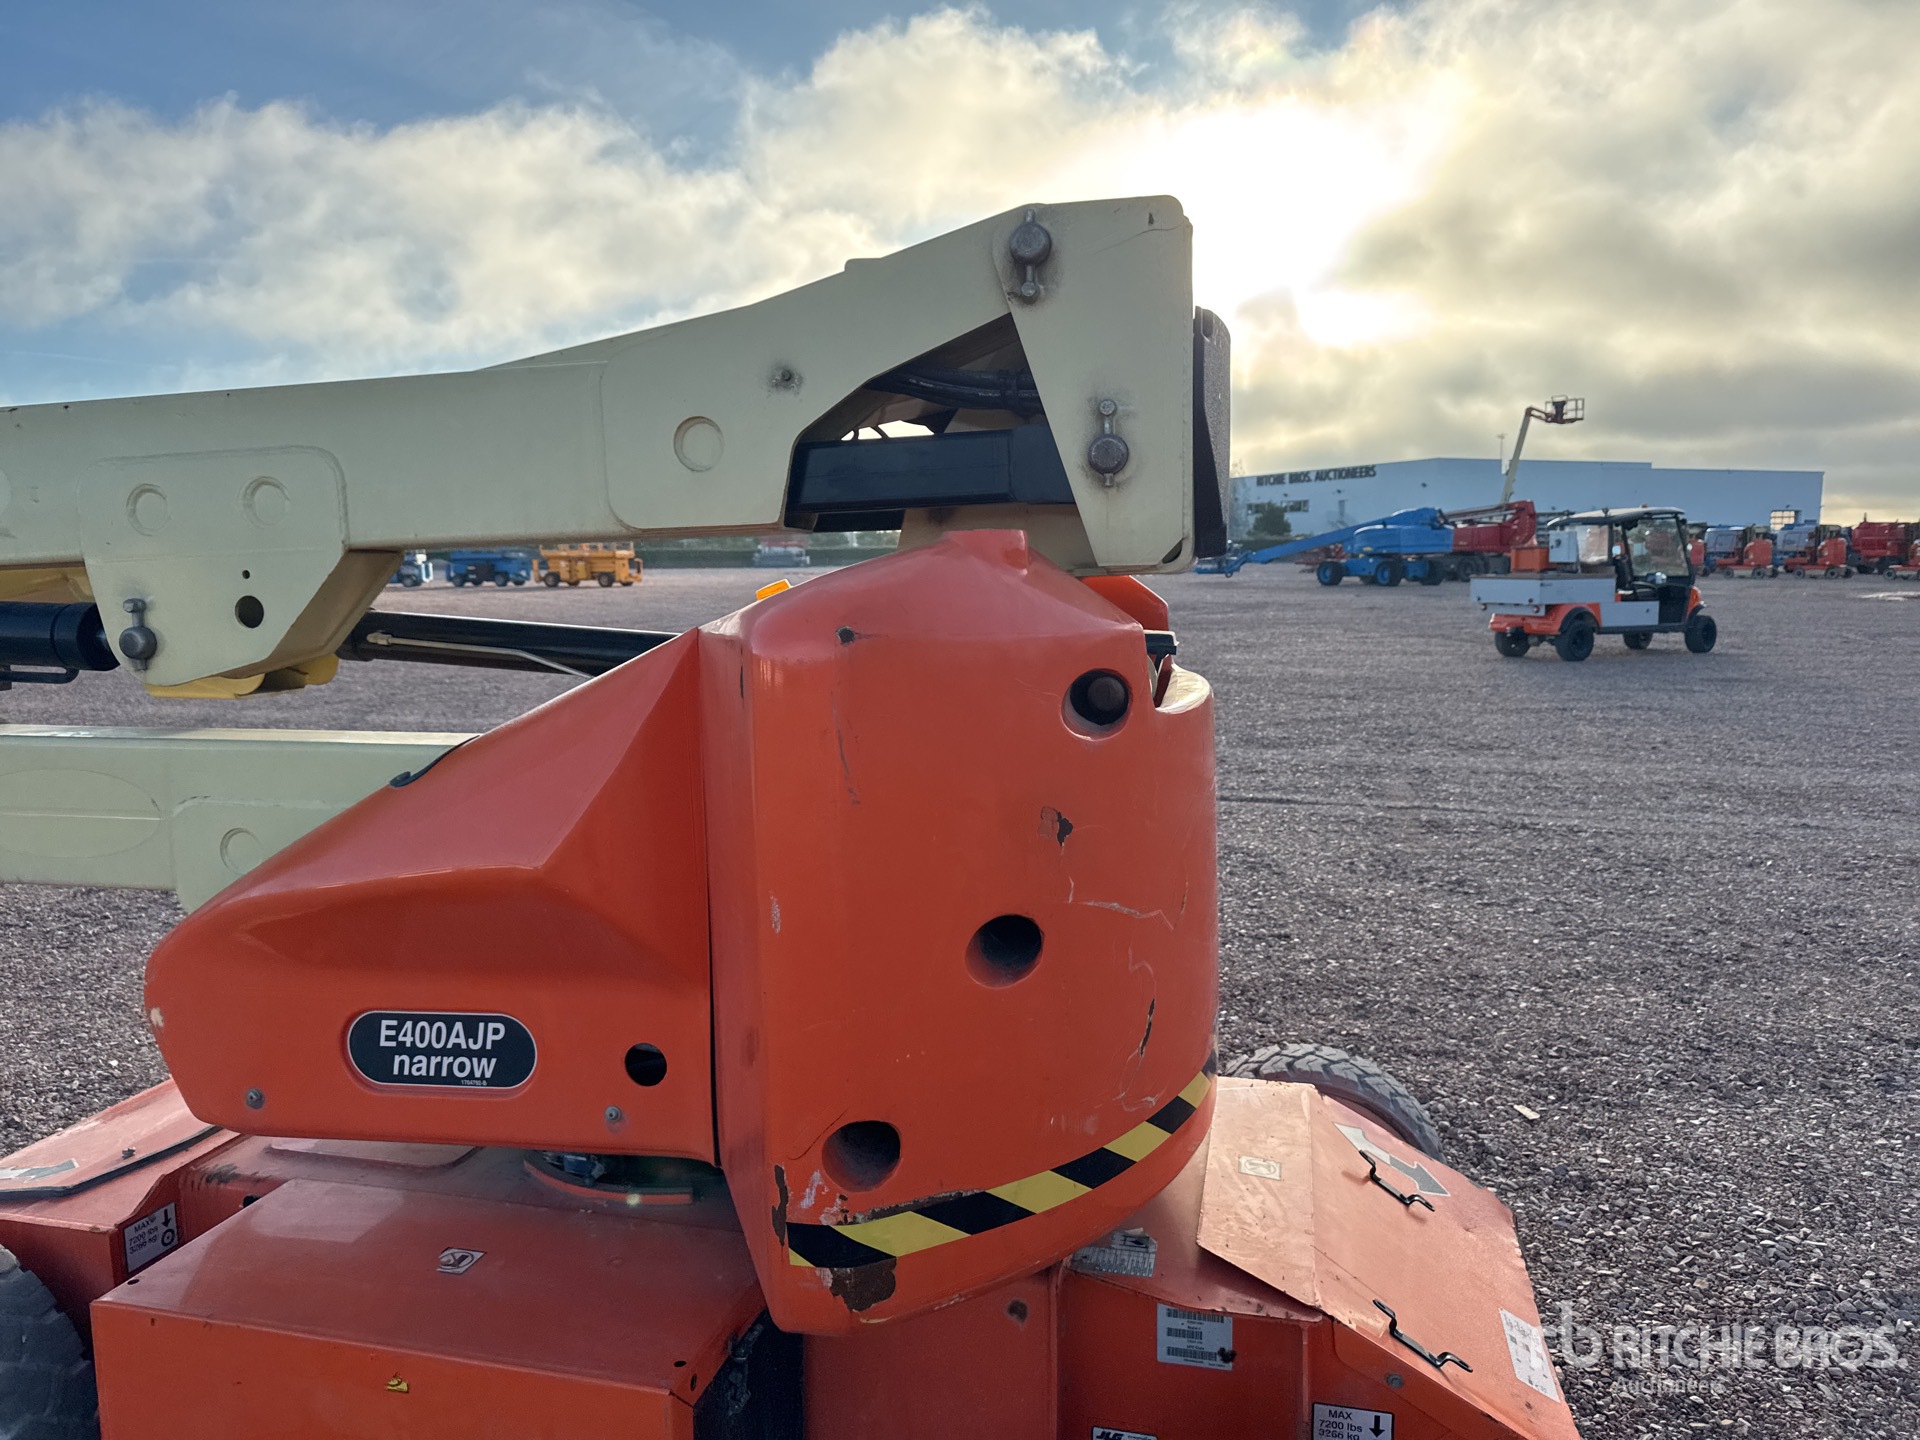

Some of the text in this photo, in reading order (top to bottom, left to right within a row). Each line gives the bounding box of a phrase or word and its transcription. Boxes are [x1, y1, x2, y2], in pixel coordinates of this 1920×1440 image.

[1314, 465, 1377, 482] AUCTIONEERS
[379, 1019, 506, 1050] E400AJP
[393, 1053, 497, 1078] narrow
[1328, 1409, 1352, 1420] MAX
[1318, 1428, 1344, 1439] 3266
[1319, 1419, 1363, 1433] 7200 lbs
